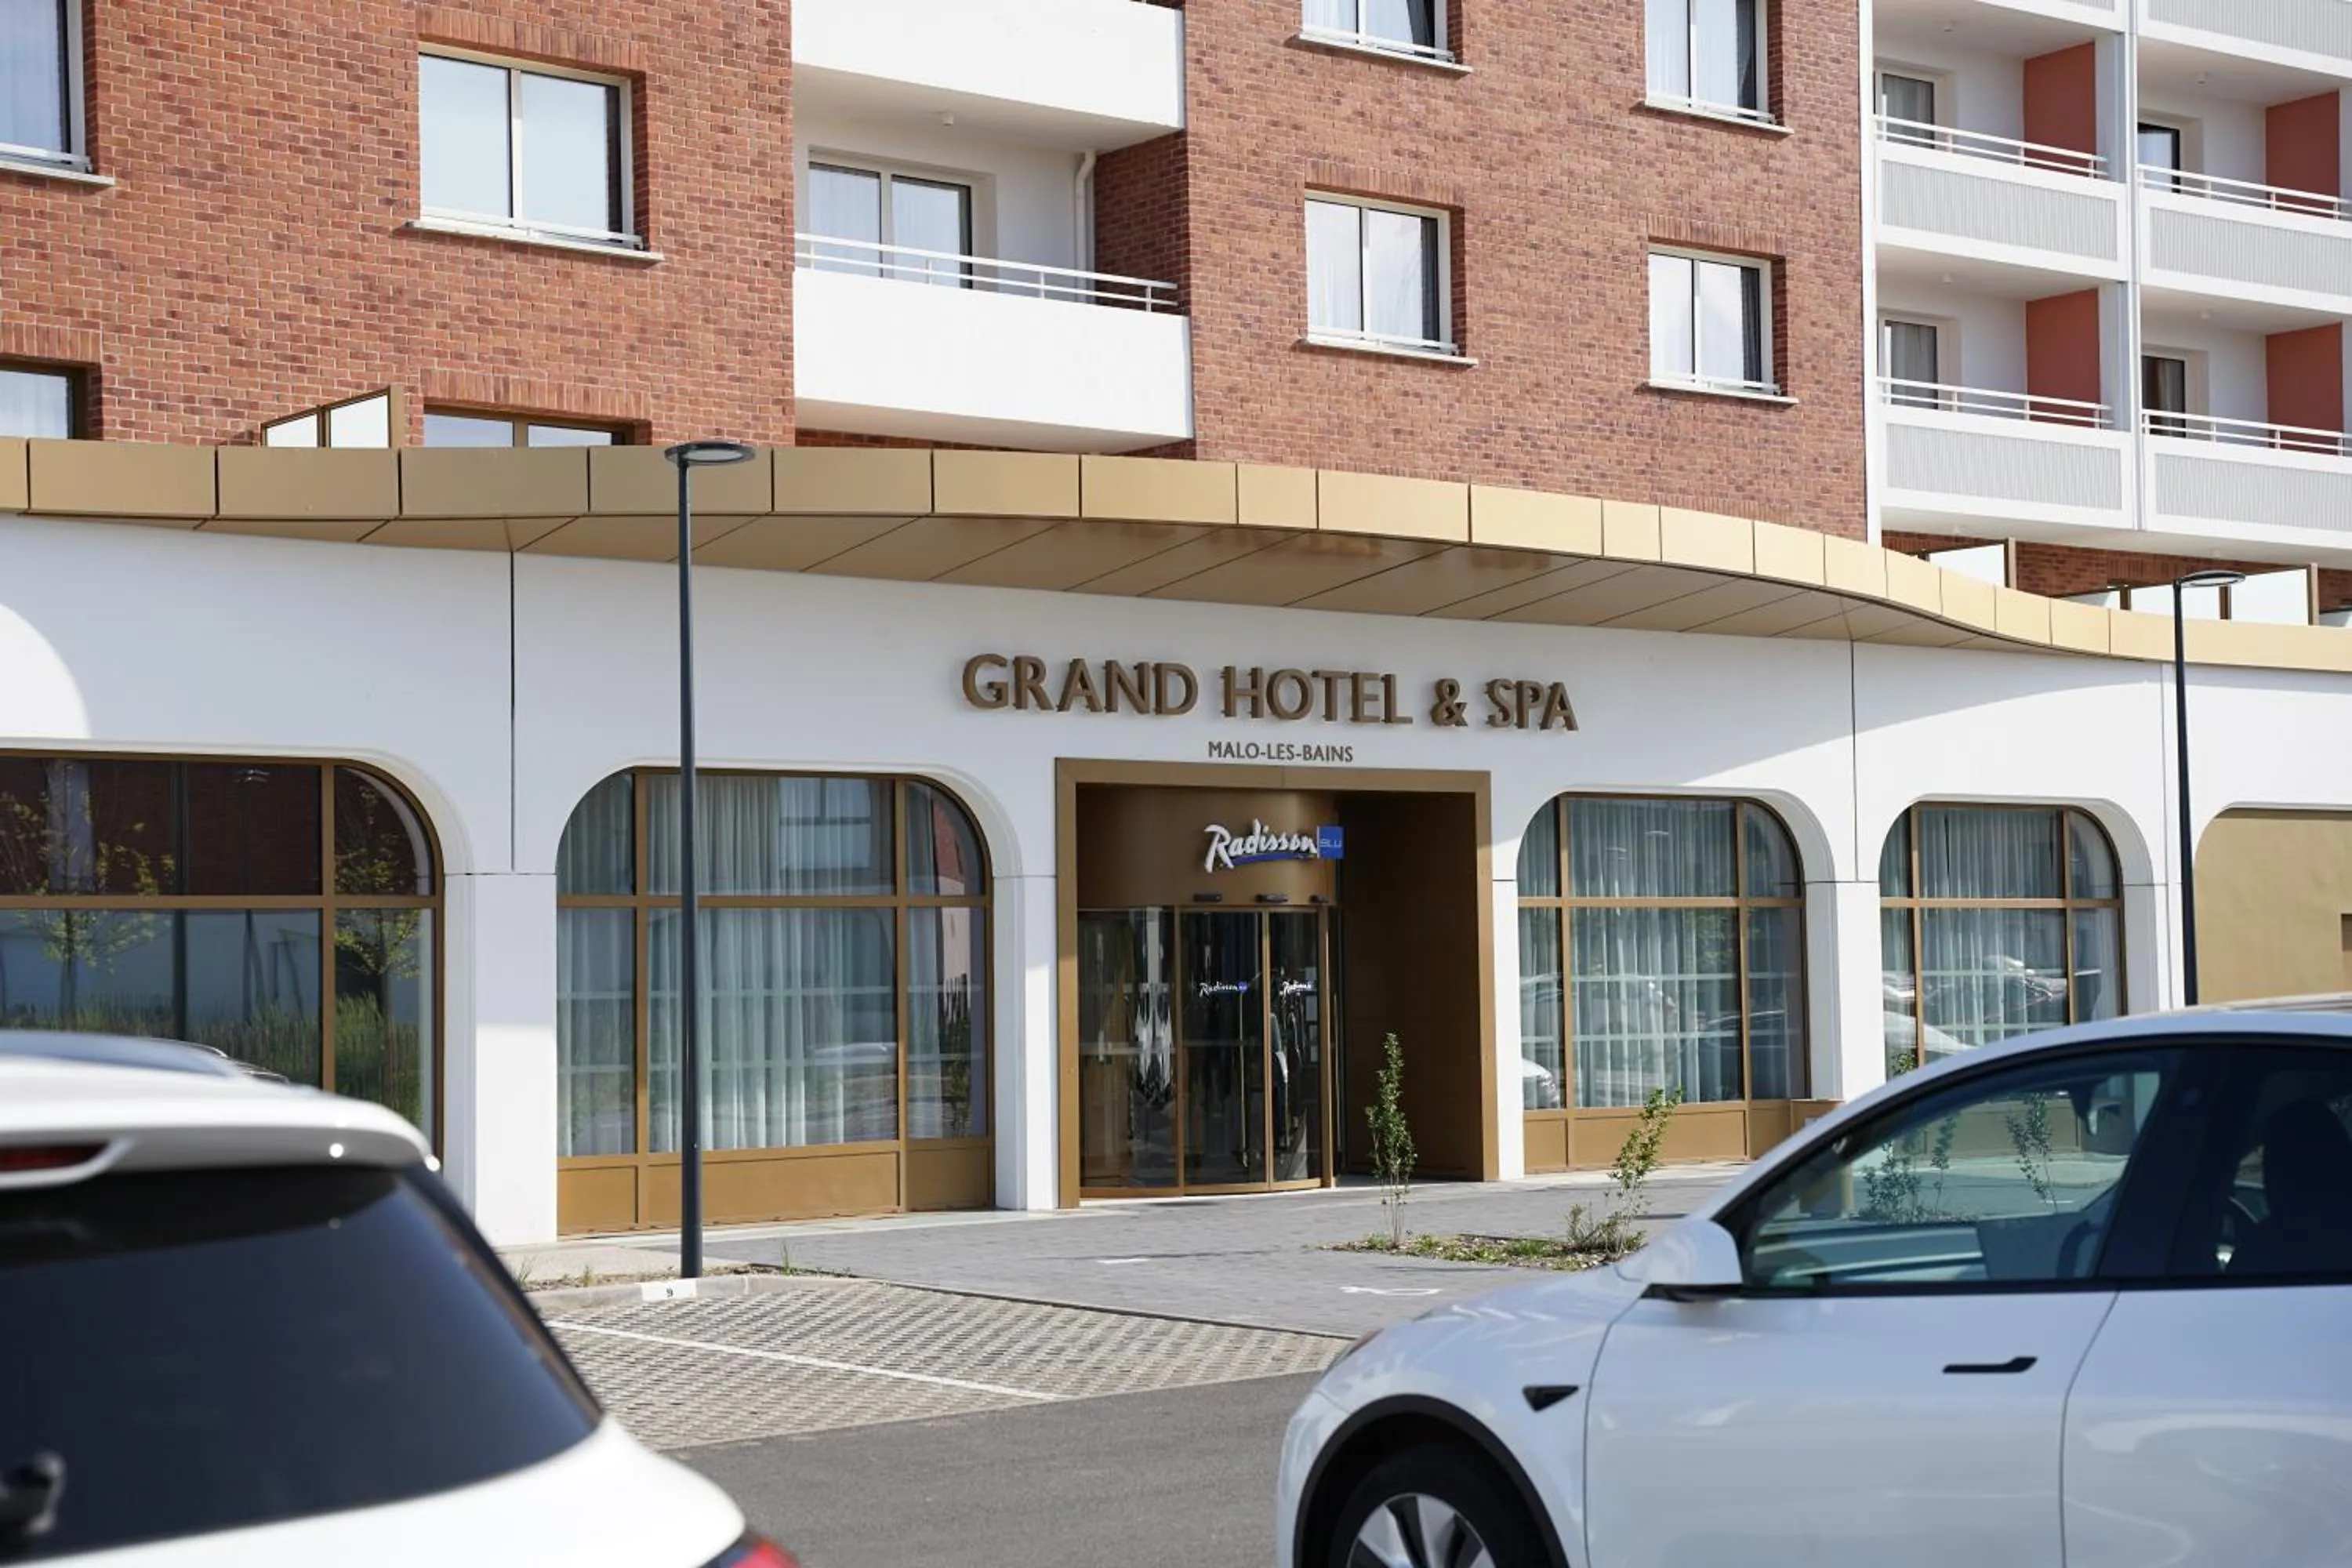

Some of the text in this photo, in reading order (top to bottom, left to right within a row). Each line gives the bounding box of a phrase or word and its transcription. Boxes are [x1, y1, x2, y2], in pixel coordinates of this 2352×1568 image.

[963, 653, 1579, 731] GRAND HOTEL & SPA
[1208, 741, 1354, 762] MALO-LES-BAINS
[1204, 818, 1342, 873] Radisson BLU
